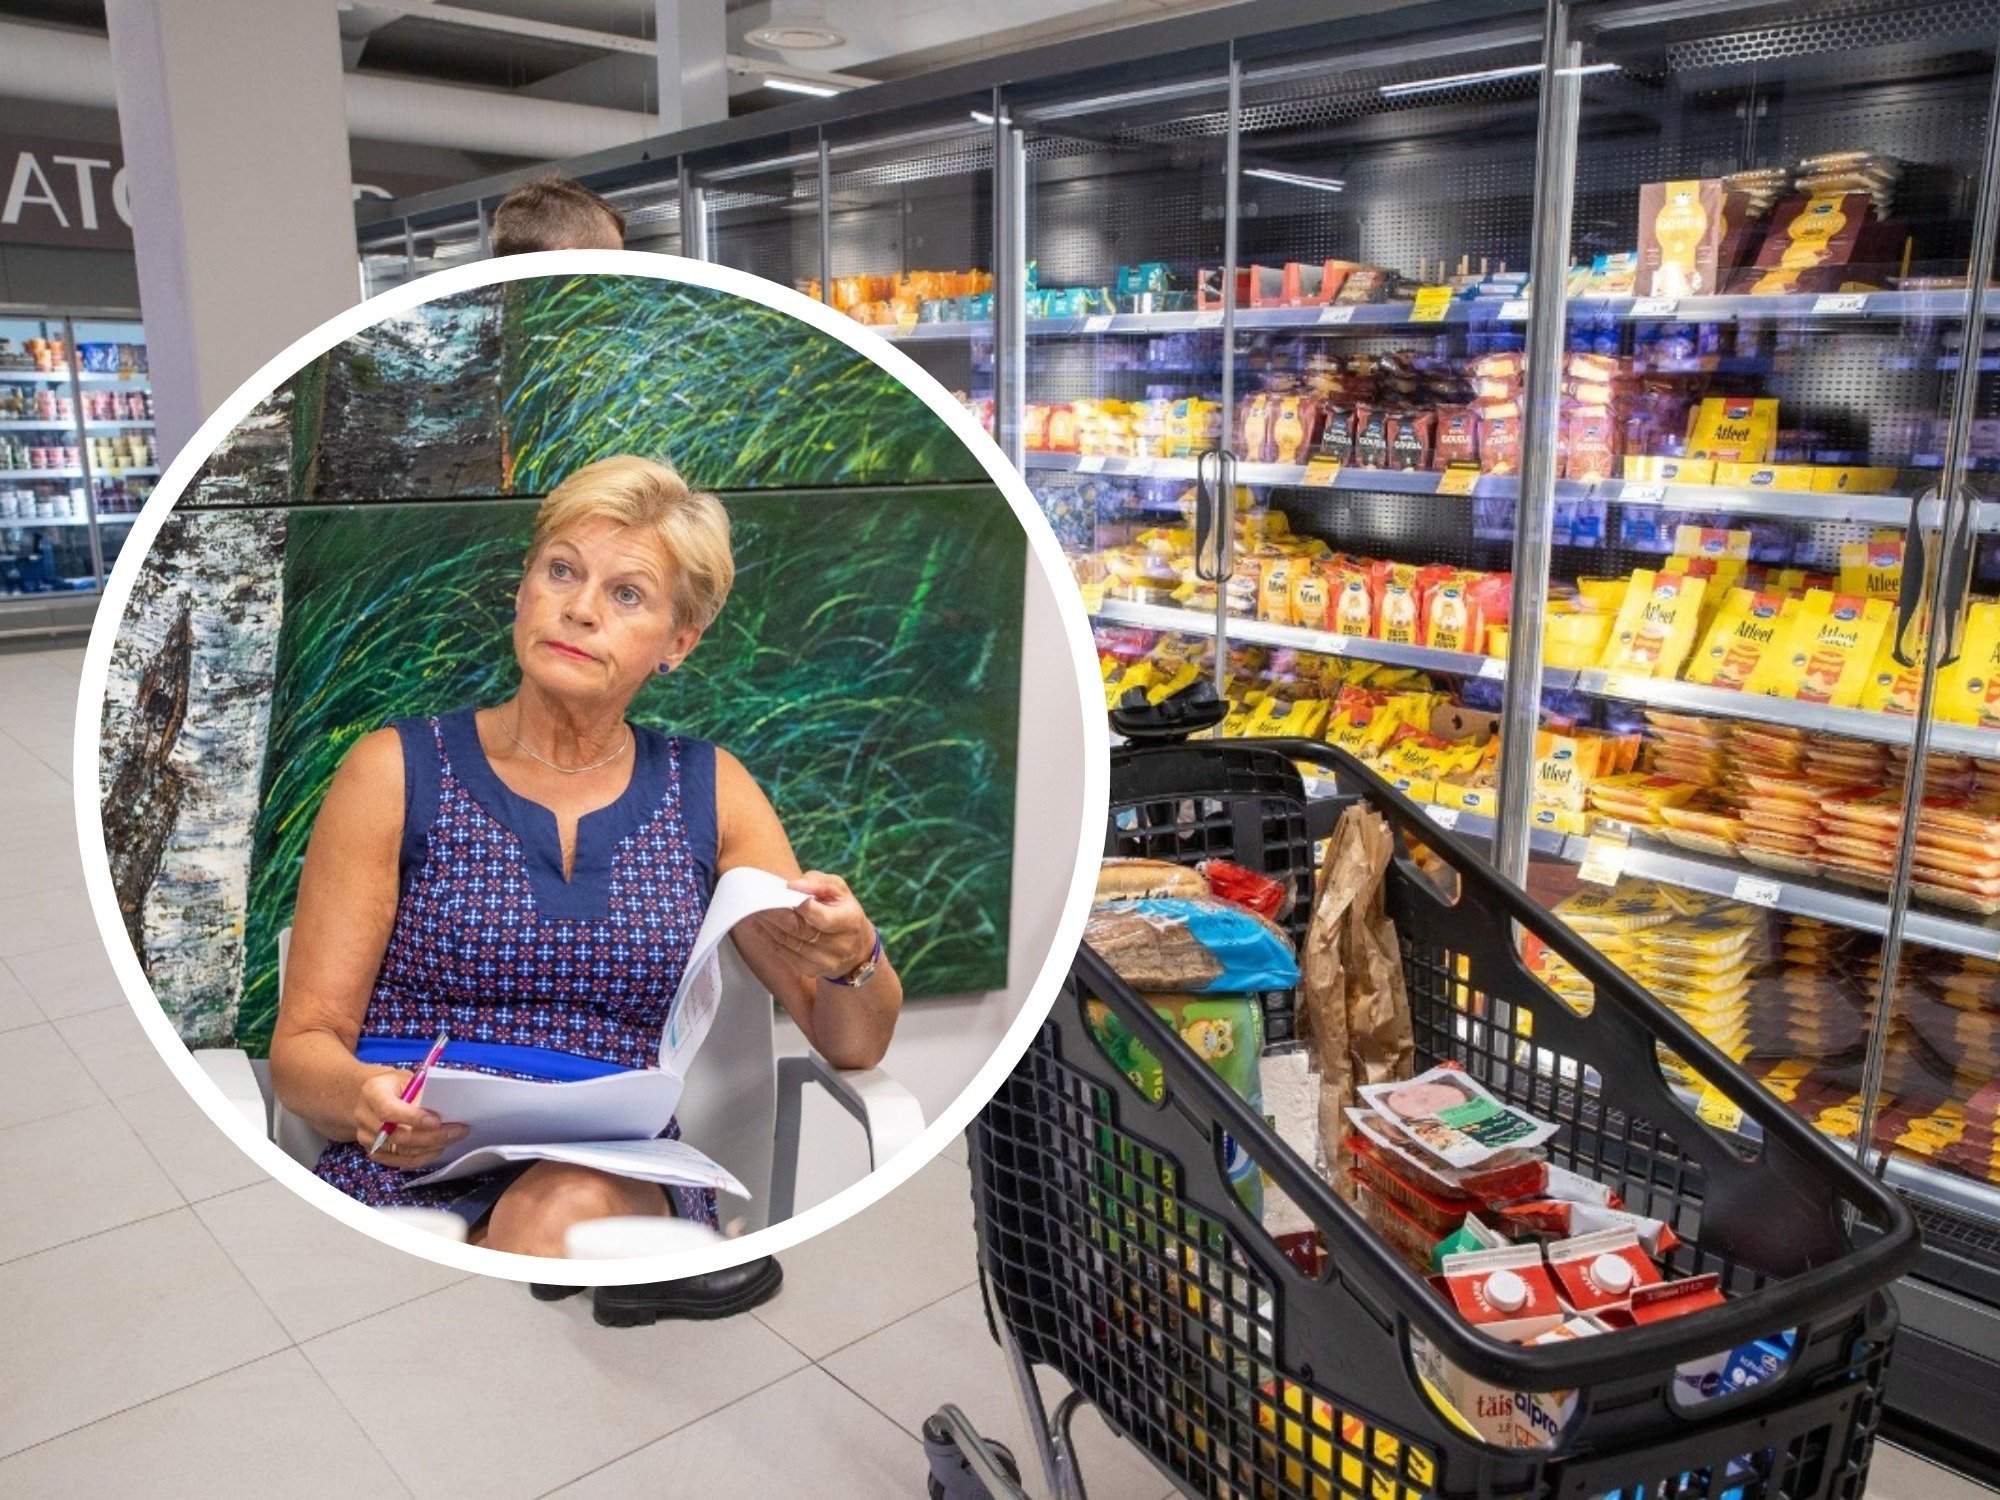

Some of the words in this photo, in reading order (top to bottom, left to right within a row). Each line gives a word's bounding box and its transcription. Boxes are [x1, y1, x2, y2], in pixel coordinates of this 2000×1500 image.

[1866, 572, 1899, 593] Atlee
[1734, 620, 1775, 643] Atleet
[1539, 762, 1574, 784] Atleet
[1477, 1394, 1512, 1418] täis
[1515, 1392, 1558, 1437] alpro
